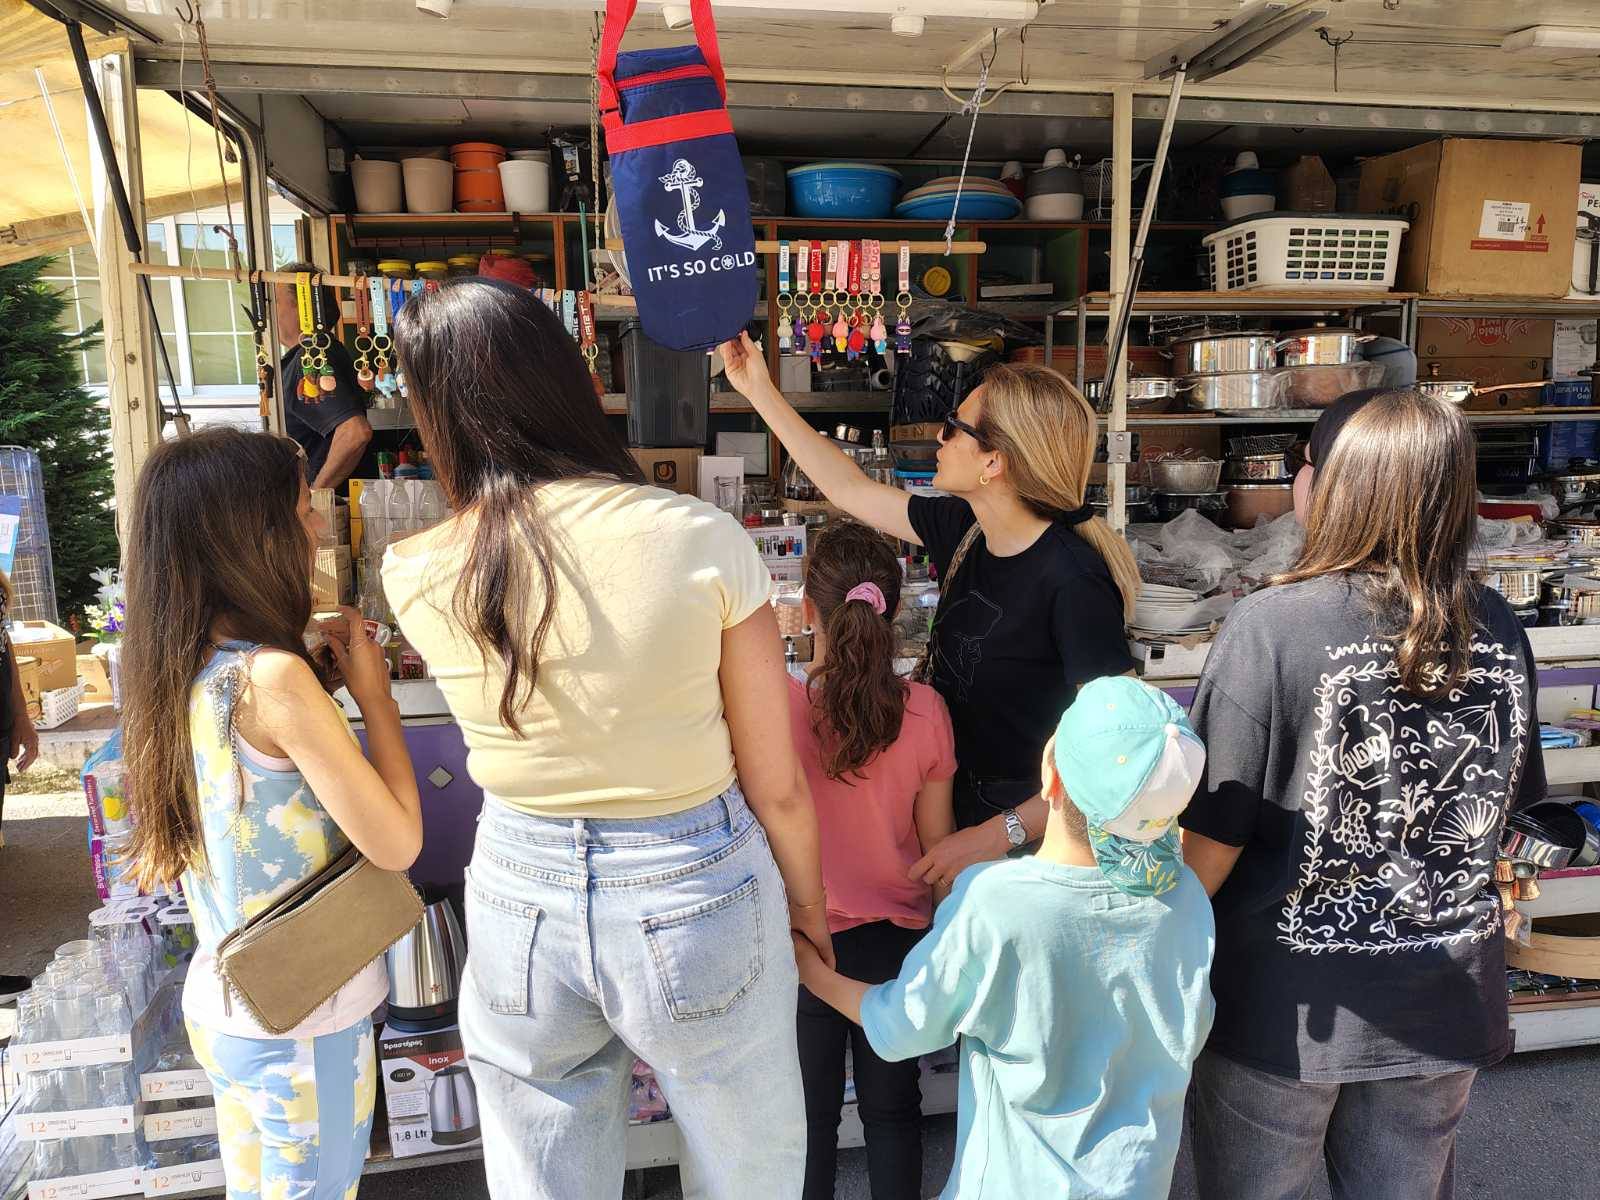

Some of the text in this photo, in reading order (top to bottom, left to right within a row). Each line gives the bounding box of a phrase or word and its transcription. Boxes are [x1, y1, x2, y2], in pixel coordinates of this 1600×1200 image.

[648, 264, 680, 282] IT'S
[683, 259, 706, 276] SO
[23, 1053, 41, 1065] 12
[428, 1056, 449, 1064] Inox
[147, 1082, 165, 1093] 12
[28, 1121, 47, 1133] 12
[154, 1120, 172, 1131] 12
[152, 1177, 170, 1189] 12
